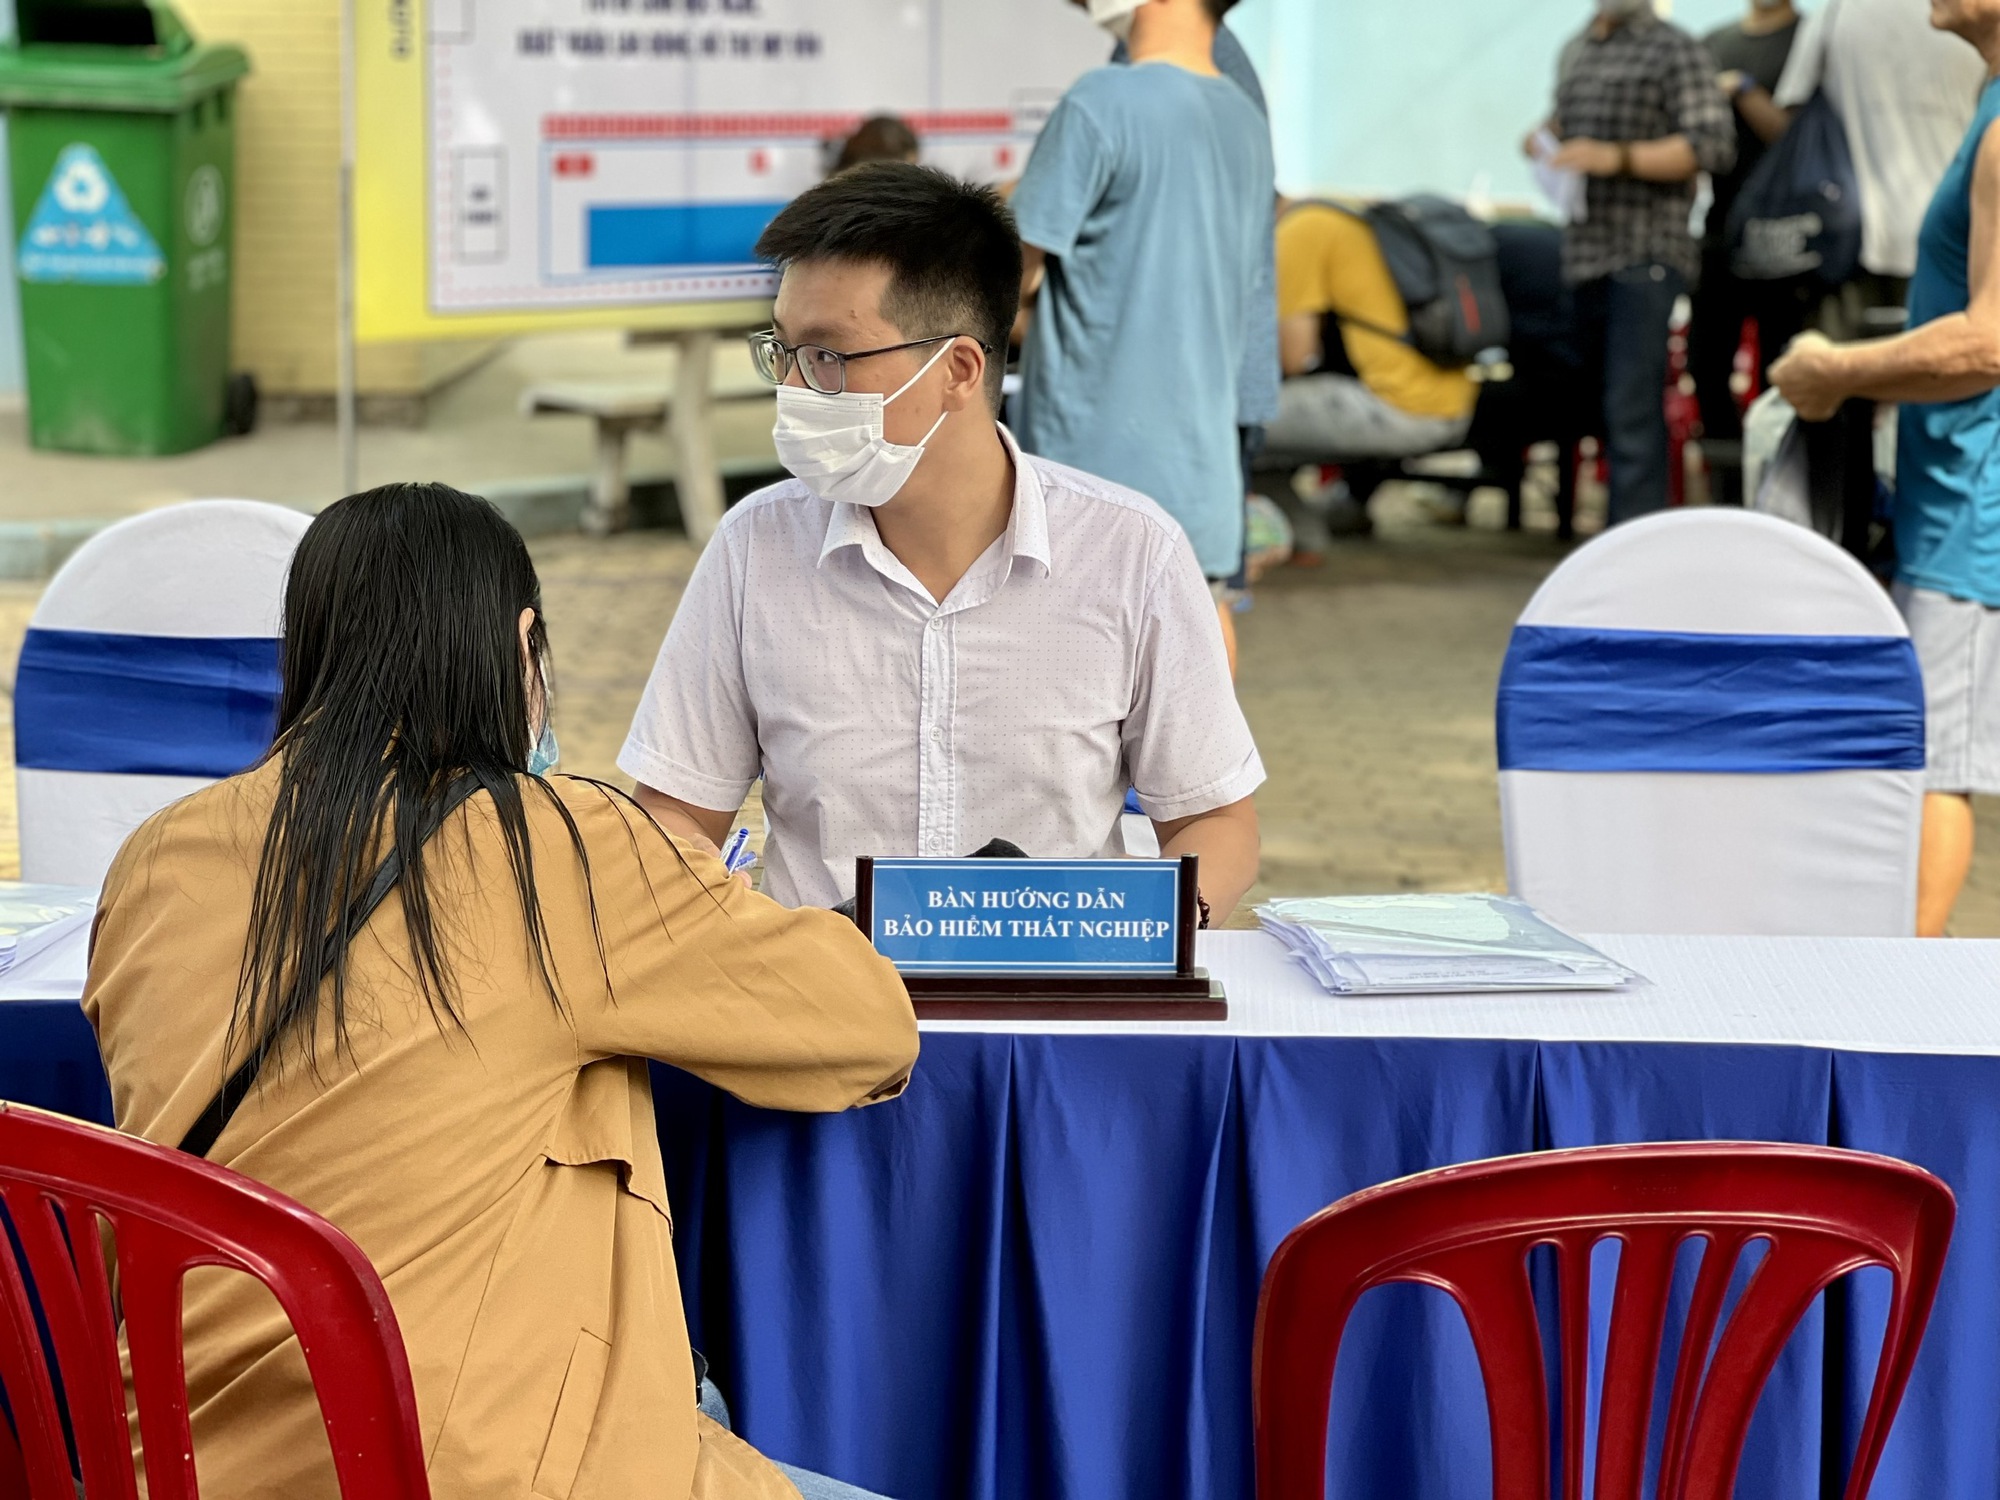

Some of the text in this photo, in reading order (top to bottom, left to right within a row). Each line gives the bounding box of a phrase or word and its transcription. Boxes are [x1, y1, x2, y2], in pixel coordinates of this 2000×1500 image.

[928, 885, 1126, 909] BÀN HƯỚNG DẪN
[883, 914, 934, 937] BẢO
[1008, 915, 1074, 938] THẤT
[1079, 918, 1170, 943] NGHIỆP
